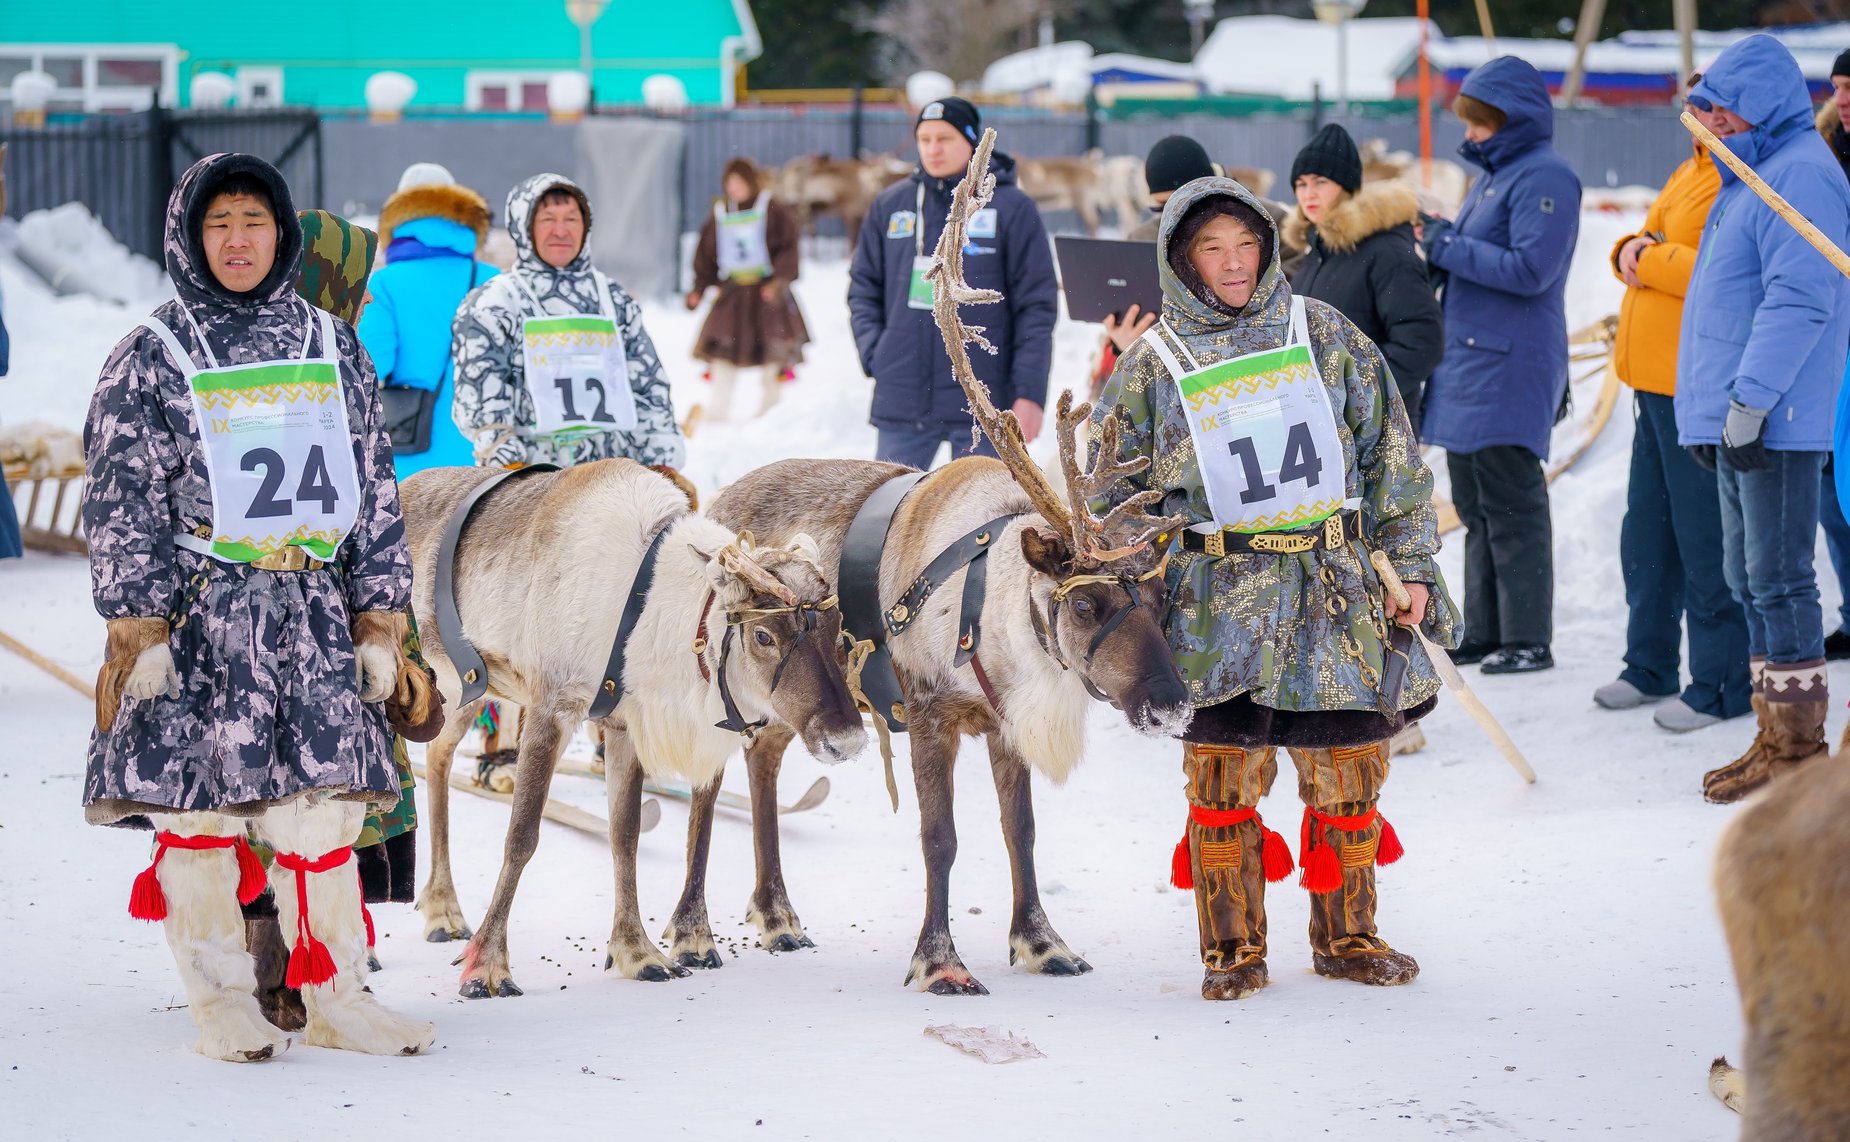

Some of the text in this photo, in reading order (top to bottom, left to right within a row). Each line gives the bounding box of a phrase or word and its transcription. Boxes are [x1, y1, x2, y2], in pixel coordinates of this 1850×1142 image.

[554, 378, 616, 422] 12
[212, 418, 232, 433] IX
[1200, 414, 1220, 432] IX
[240, 444, 339, 518] 24
[1228, 421, 1322, 504] 14
